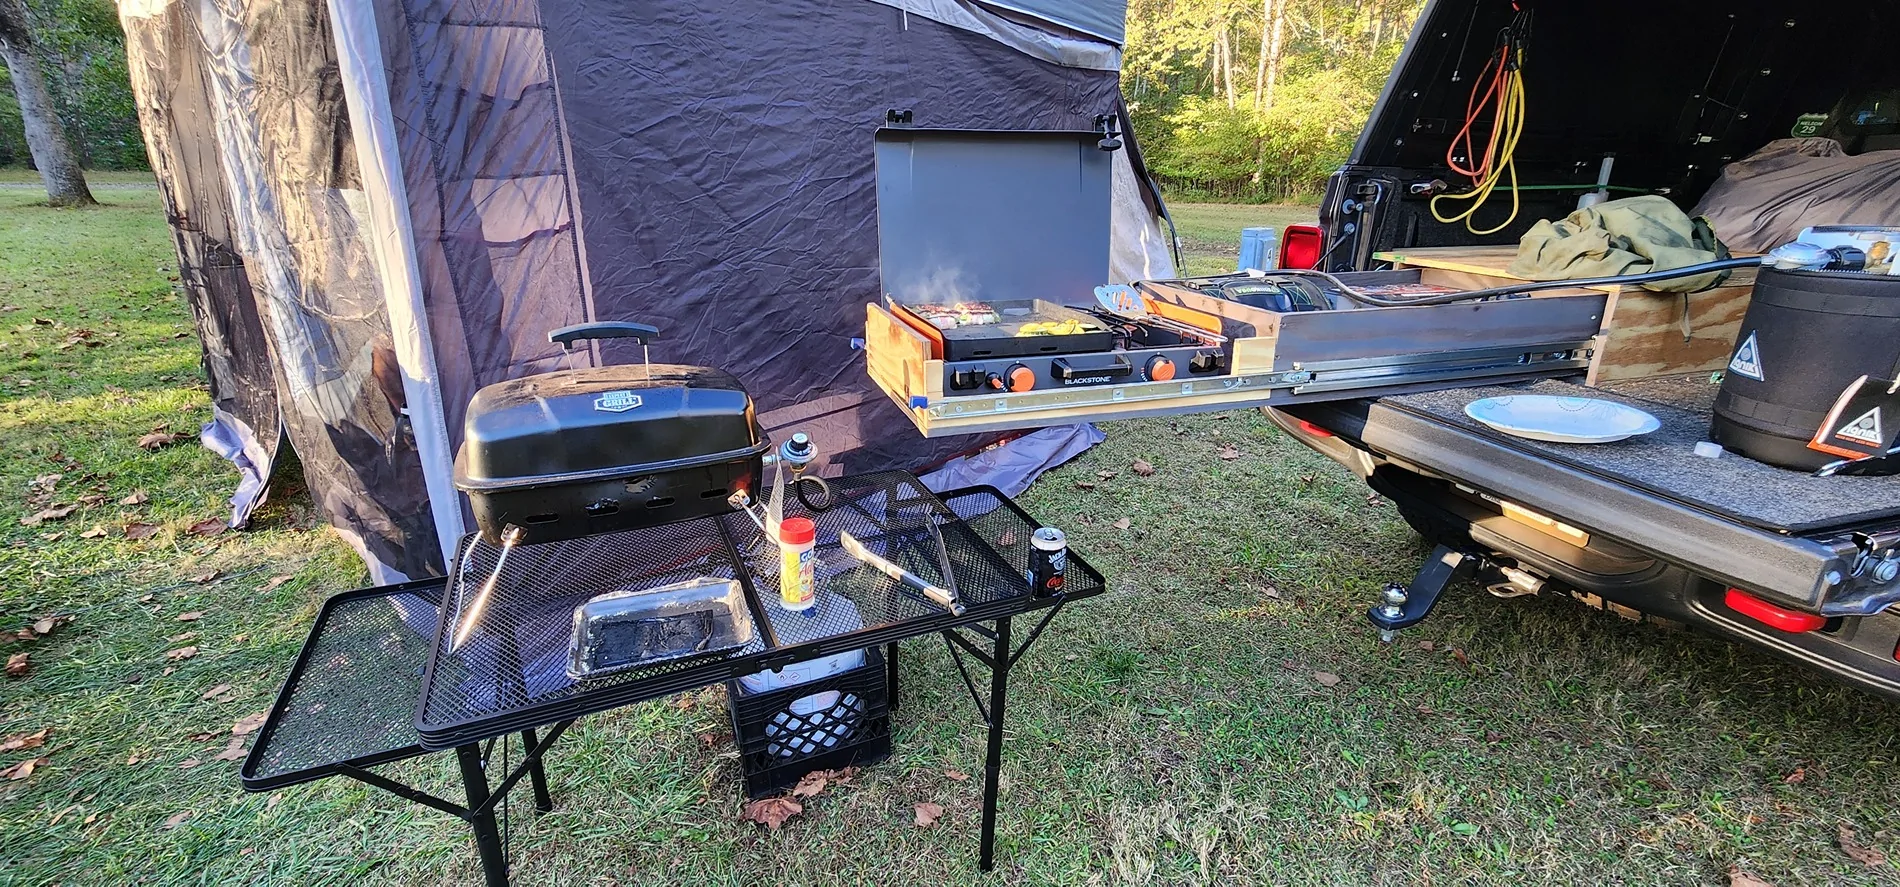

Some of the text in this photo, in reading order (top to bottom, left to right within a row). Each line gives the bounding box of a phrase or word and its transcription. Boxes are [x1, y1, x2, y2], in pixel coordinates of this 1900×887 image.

[1064, 376, 1111, 385] BLACKSTONE
[602, 397, 637, 407] GRILL
[800, 550, 814, 562] GO
